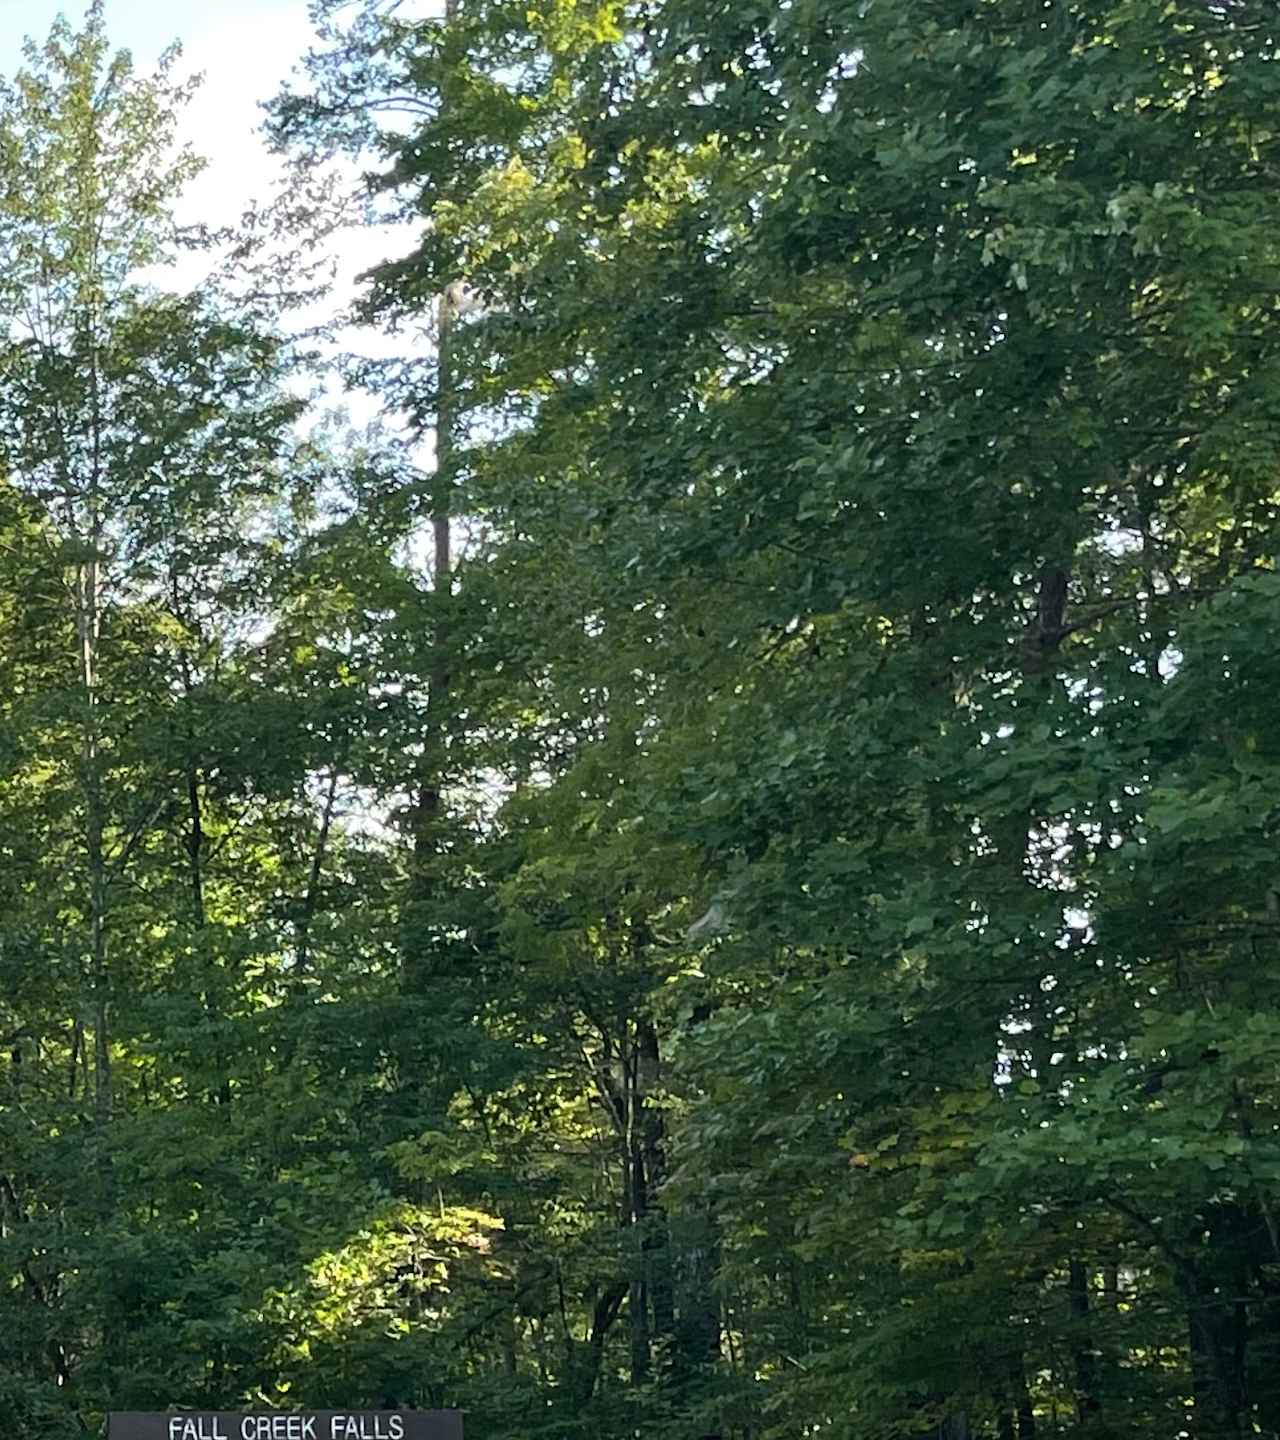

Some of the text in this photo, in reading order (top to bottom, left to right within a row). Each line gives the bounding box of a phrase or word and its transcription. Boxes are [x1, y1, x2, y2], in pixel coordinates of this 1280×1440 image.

[169, 1415, 403, 1440] FALL CREEK FALLS
